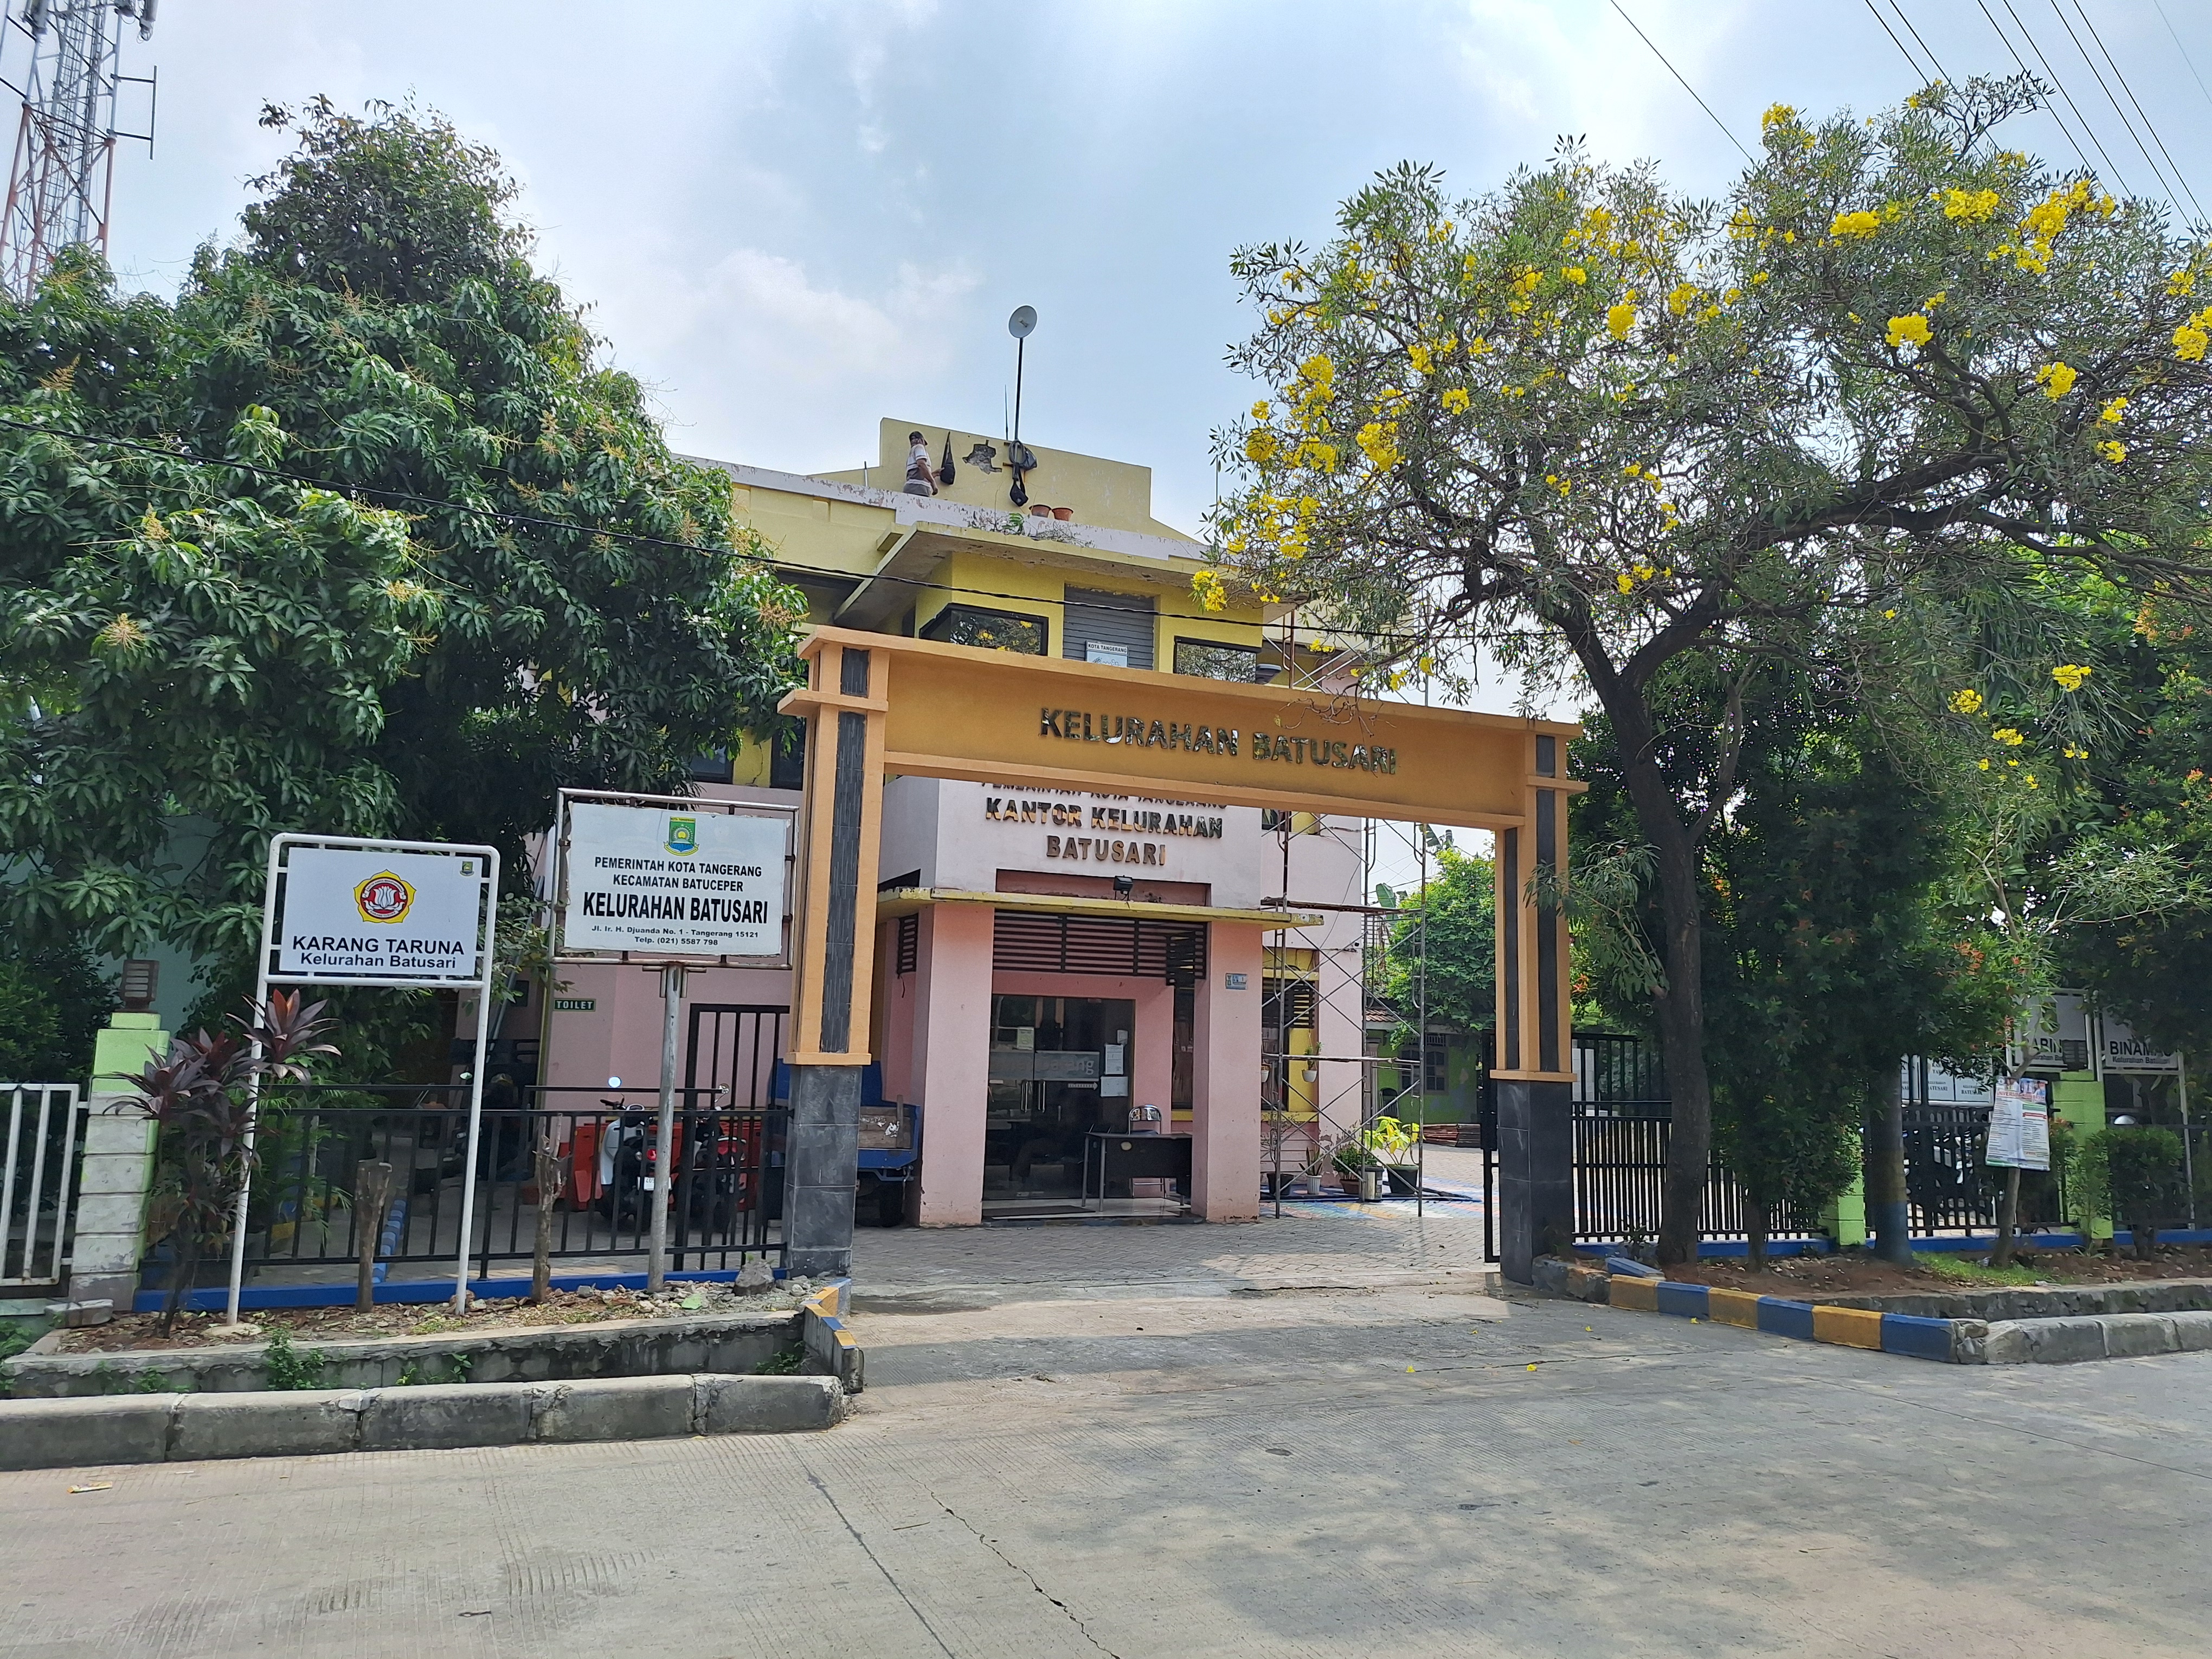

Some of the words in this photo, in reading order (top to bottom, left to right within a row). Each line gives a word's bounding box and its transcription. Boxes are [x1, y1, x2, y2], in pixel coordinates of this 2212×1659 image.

[1040, 708, 1238, 756] KELURAHAN
[1252, 732, 1397, 775] BATUSARI
[986, 797, 1082, 827] KANTOR
[1091, 807, 1223, 838] KELURAHAN
[1046, 835, 1166, 866] BATUSARI
[595, 857, 665, 872] PEMERINTAH
[668, 861, 696, 873] KOTA
[699, 863, 762, 877] TANGERANG
[613, 874, 679, 888] KECAMATAN
[683, 878, 743, 892] BATUCEPER
[583, 892, 685, 920] KELURAHAN
[690, 897, 768, 924] BATUSARI
[658, 937, 678, 946] (021)
[691, 929, 732, 938] Tangerang
[293, 936, 379, 953] KARANG
[385, 939, 465, 955] TARUNA
[301, 953, 384, 967] Kelurahan
[390, 955, 456, 968] Batusari
[556, 1001, 593, 1009] TOILET
